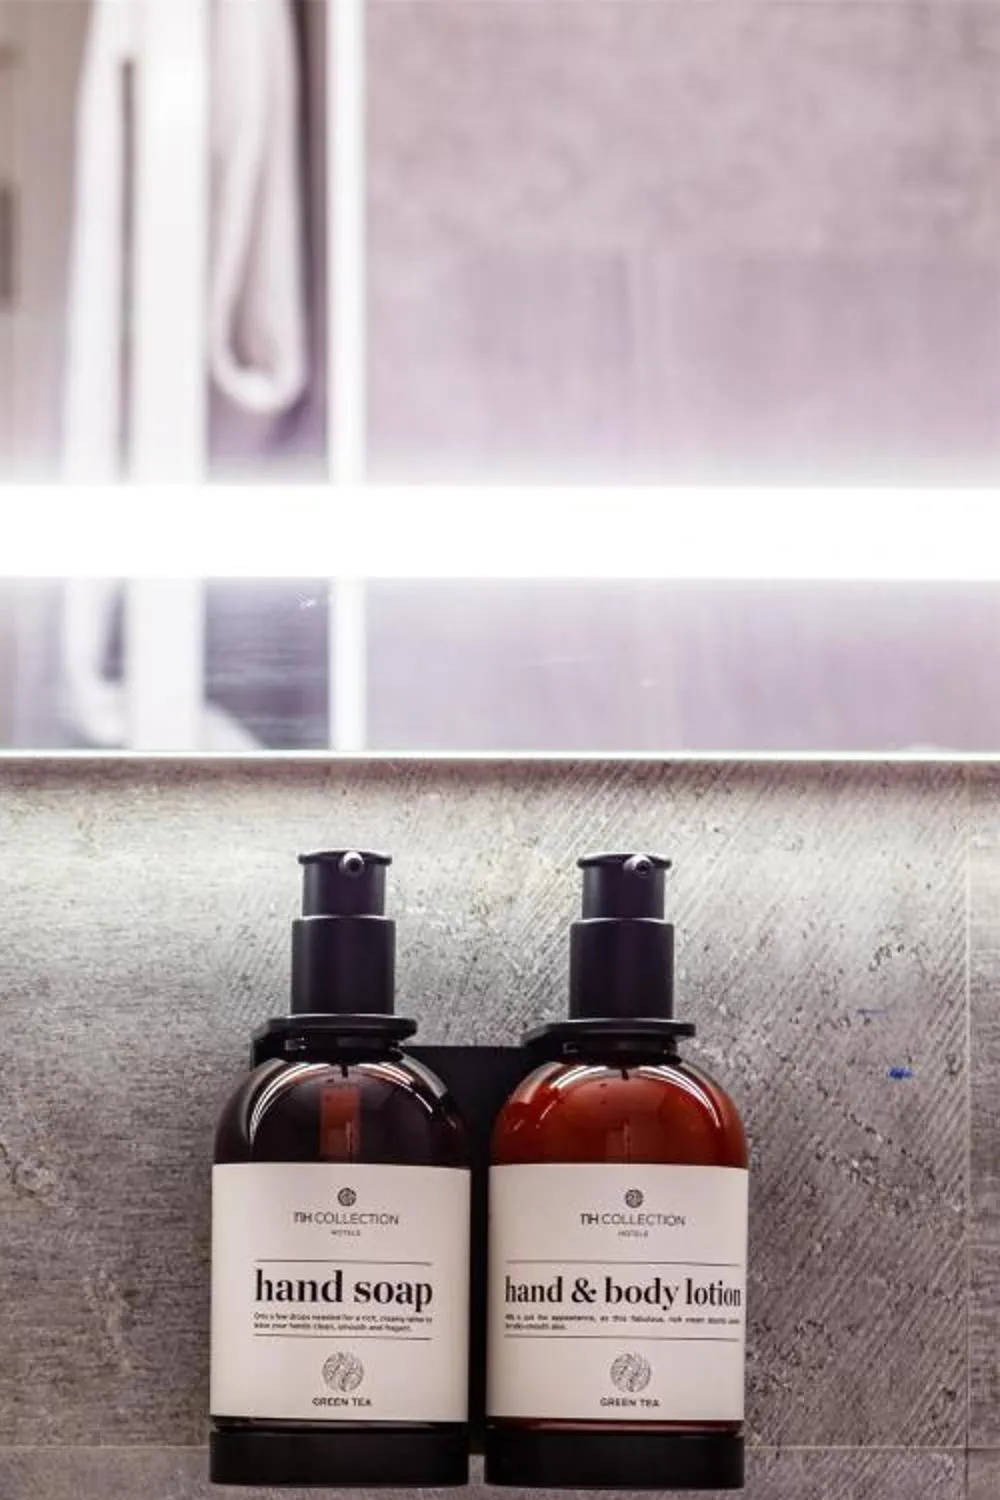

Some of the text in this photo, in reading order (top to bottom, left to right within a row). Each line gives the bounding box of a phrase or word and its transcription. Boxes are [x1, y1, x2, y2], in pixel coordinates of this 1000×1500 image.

[314, 1211, 399, 1225] COLLECTION
[601, 1213, 686, 1226] COLLECTION
[254, 1269, 433, 1312] hand soap
[505, 1276, 741, 1311] hand & body lotion
[312, 1396, 372, 1407] GREEN TEA
[600, 1397, 661, 1407] GREEN TEA
